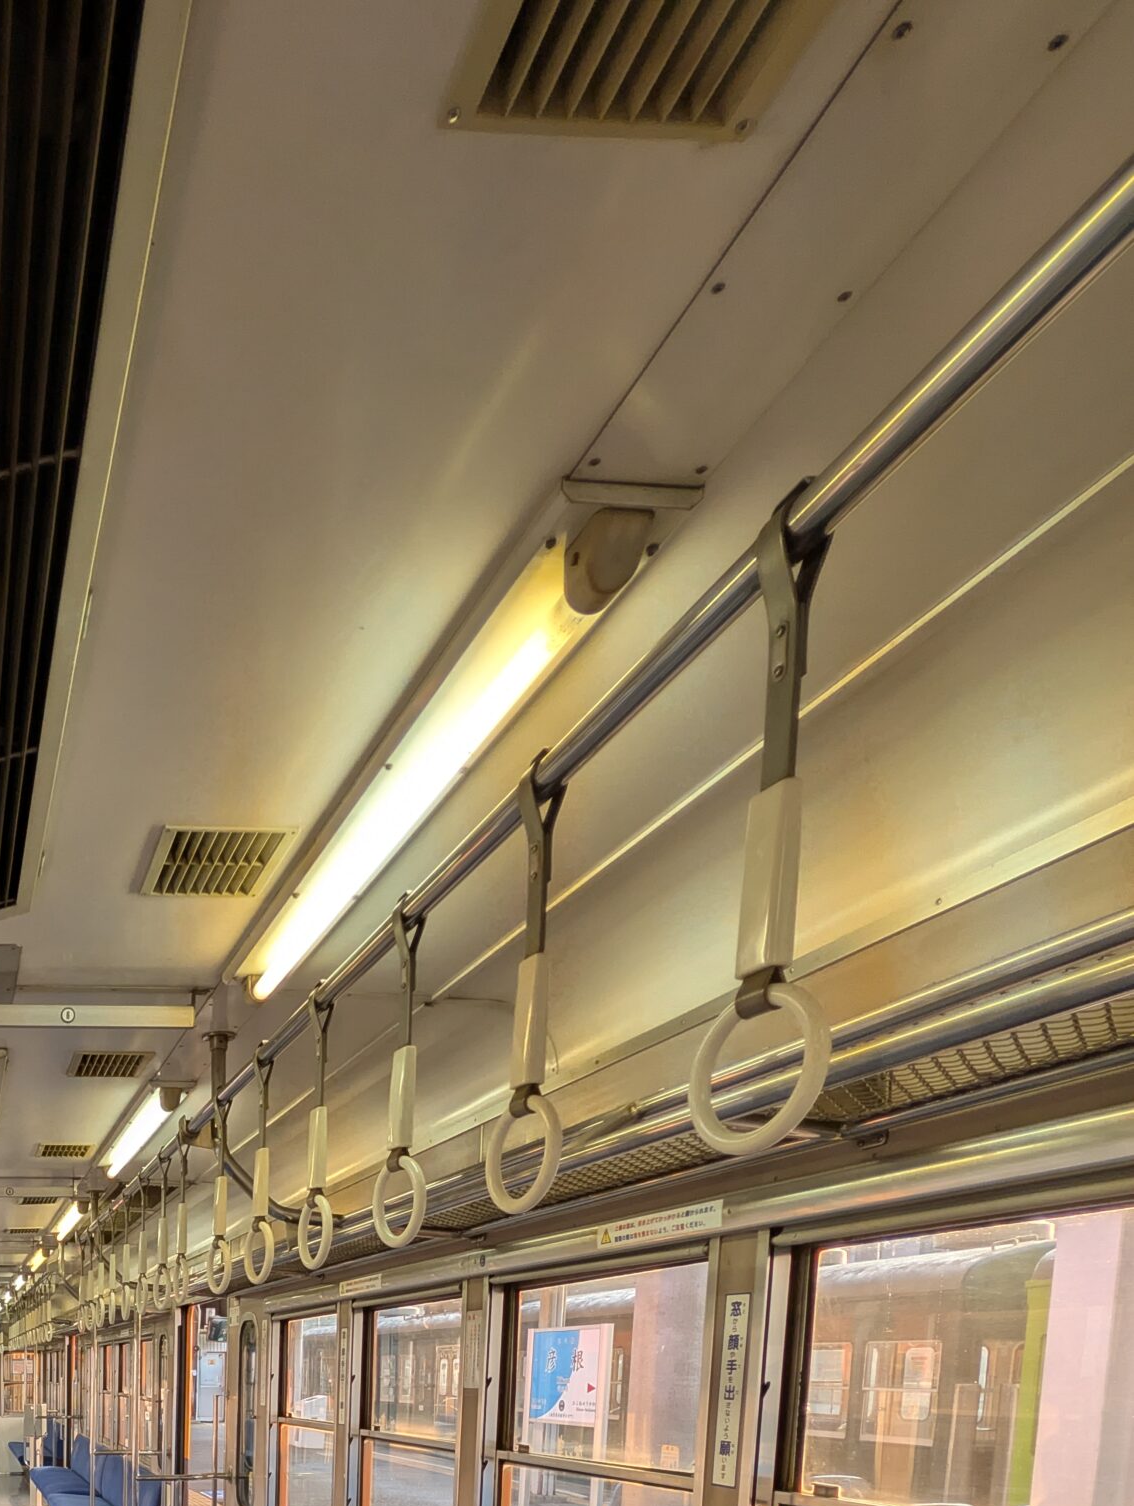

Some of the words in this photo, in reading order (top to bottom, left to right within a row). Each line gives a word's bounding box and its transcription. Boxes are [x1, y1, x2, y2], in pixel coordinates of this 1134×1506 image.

[545, 1346, 585, 1374] 彦根
[719, 1301, 743, 1480] 窓から顔や手を出さないよう願います
